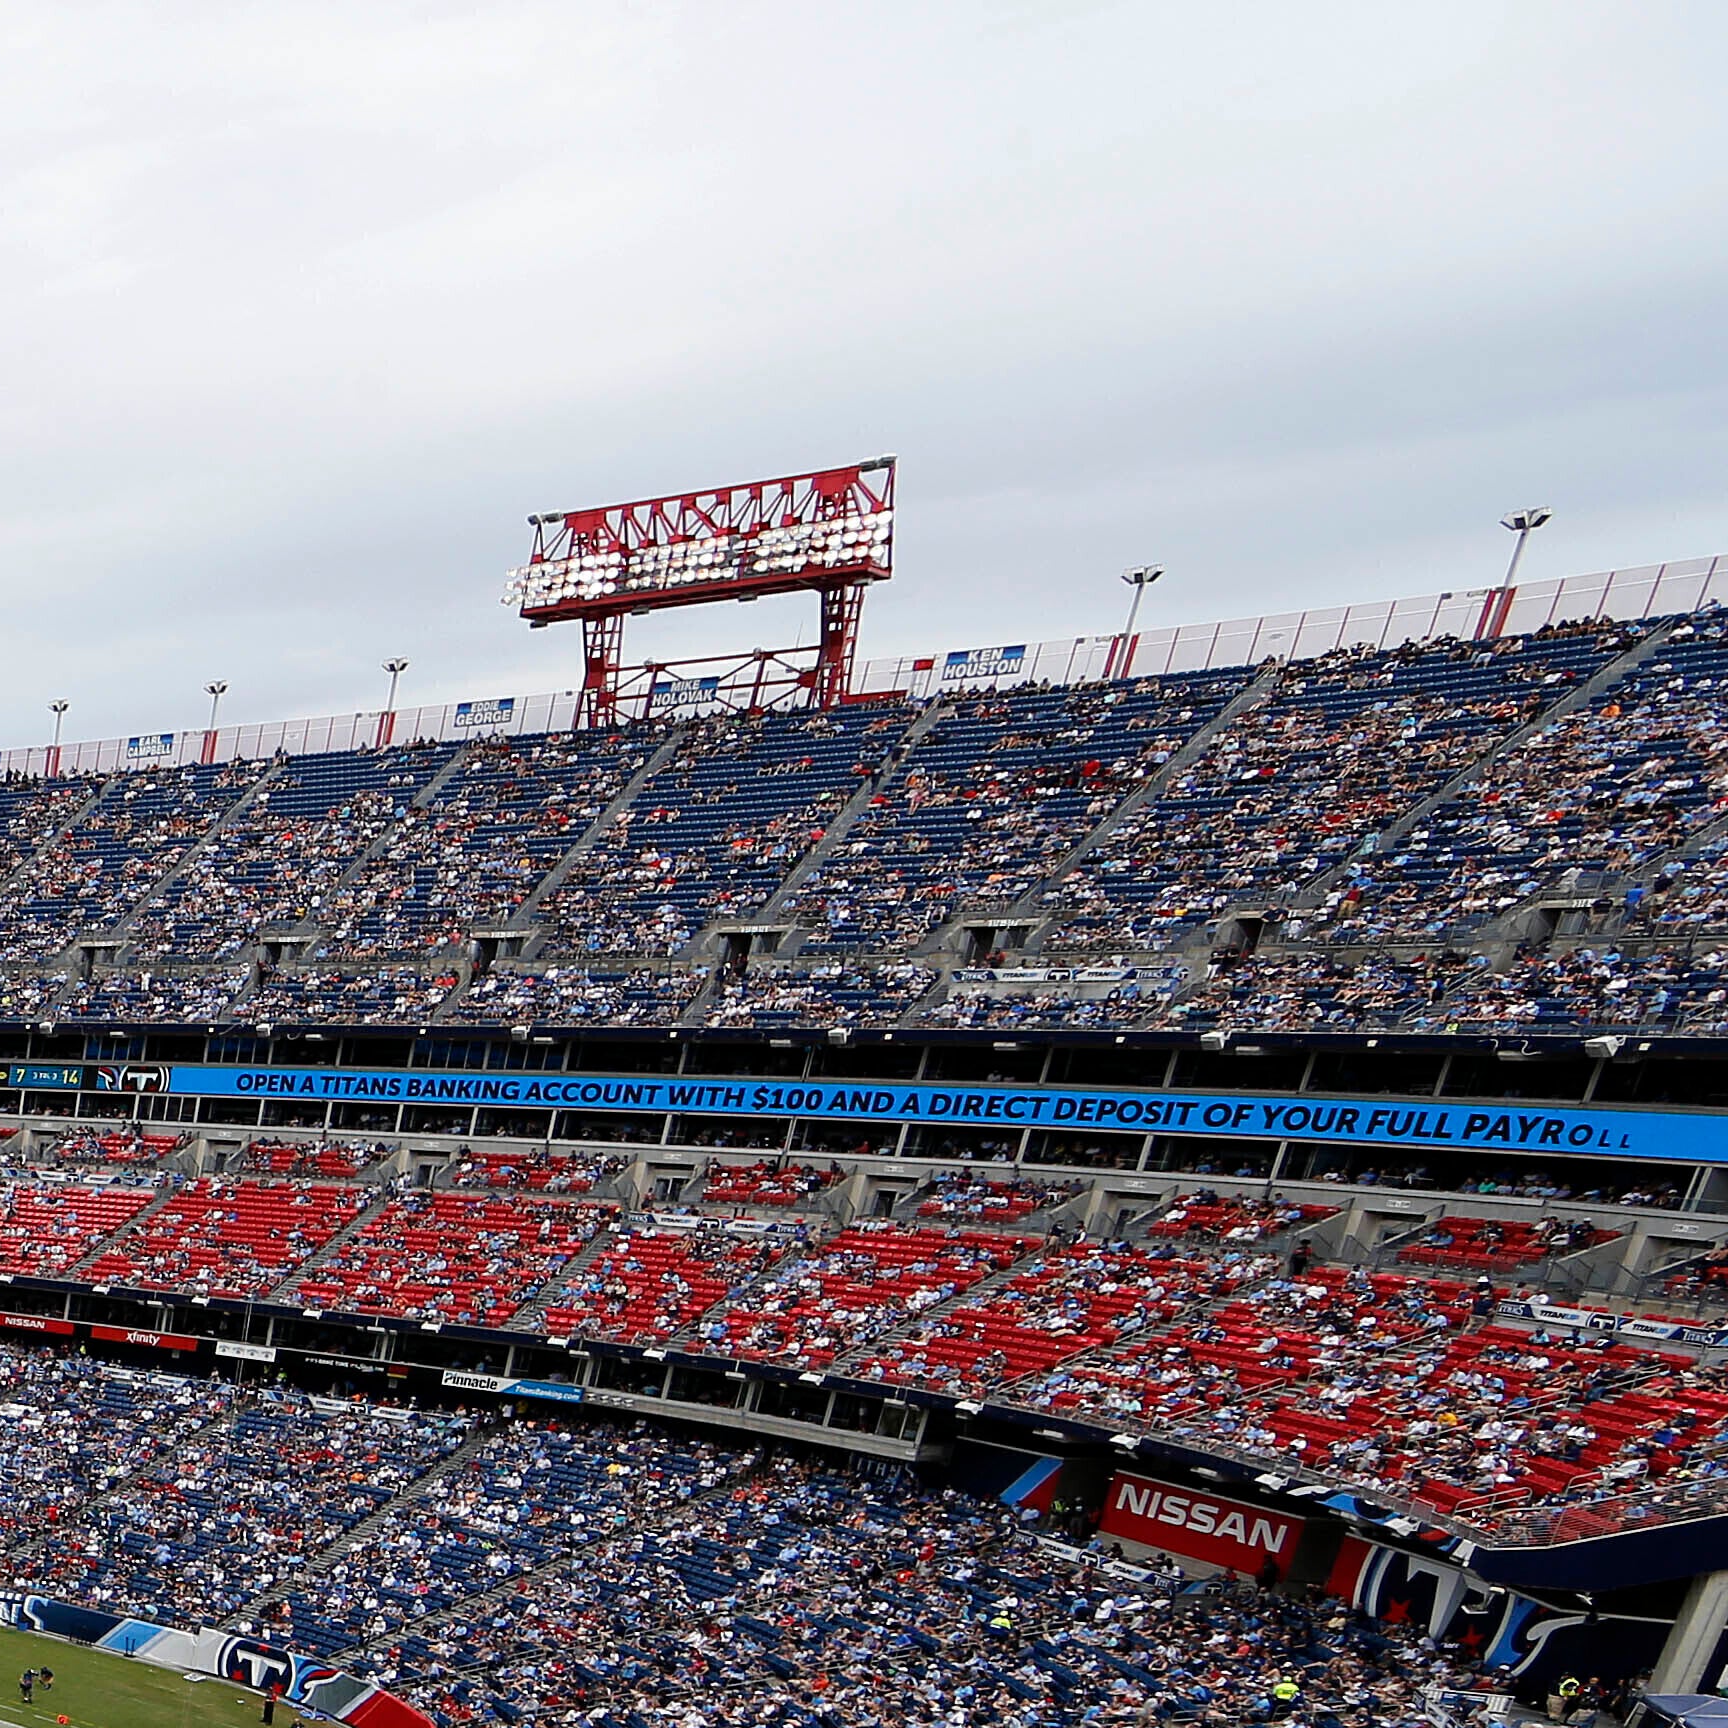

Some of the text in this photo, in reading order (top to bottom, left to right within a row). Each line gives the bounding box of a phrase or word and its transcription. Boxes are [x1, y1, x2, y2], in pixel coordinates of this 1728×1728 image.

[967, 648, 1002, 662] KEN
[944, 658, 1022, 680] HOUSTON
[670, 680, 701, 691] MIKE
[652, 689, 716, 708] HOLOVAK
[469, 701, 497, 711] EDDIE
[455, 709, 510, 726] GEORGE
[139, 736, 161, 745] EARL
[128, 743, 171, 757] CAMPBELL
[15, 1069, 25, 1083] 7
[62, 1070, 79, 1085] 14
[236, 1073, 1632, 1150] OPEN A TITANS BANKING ACCOUNT WITH $100 AND A DIRECT DEPOSIT OF YOUR FULL PAYROLL
[5, 1317, 45, 1329] NISSAN
[126, 1332, 161, 1346] xfinity
[444, 1372, 580, 1401] Pinnacle TitansBanking.com
[1116, 1484, 1288, 1553] NISSAN
